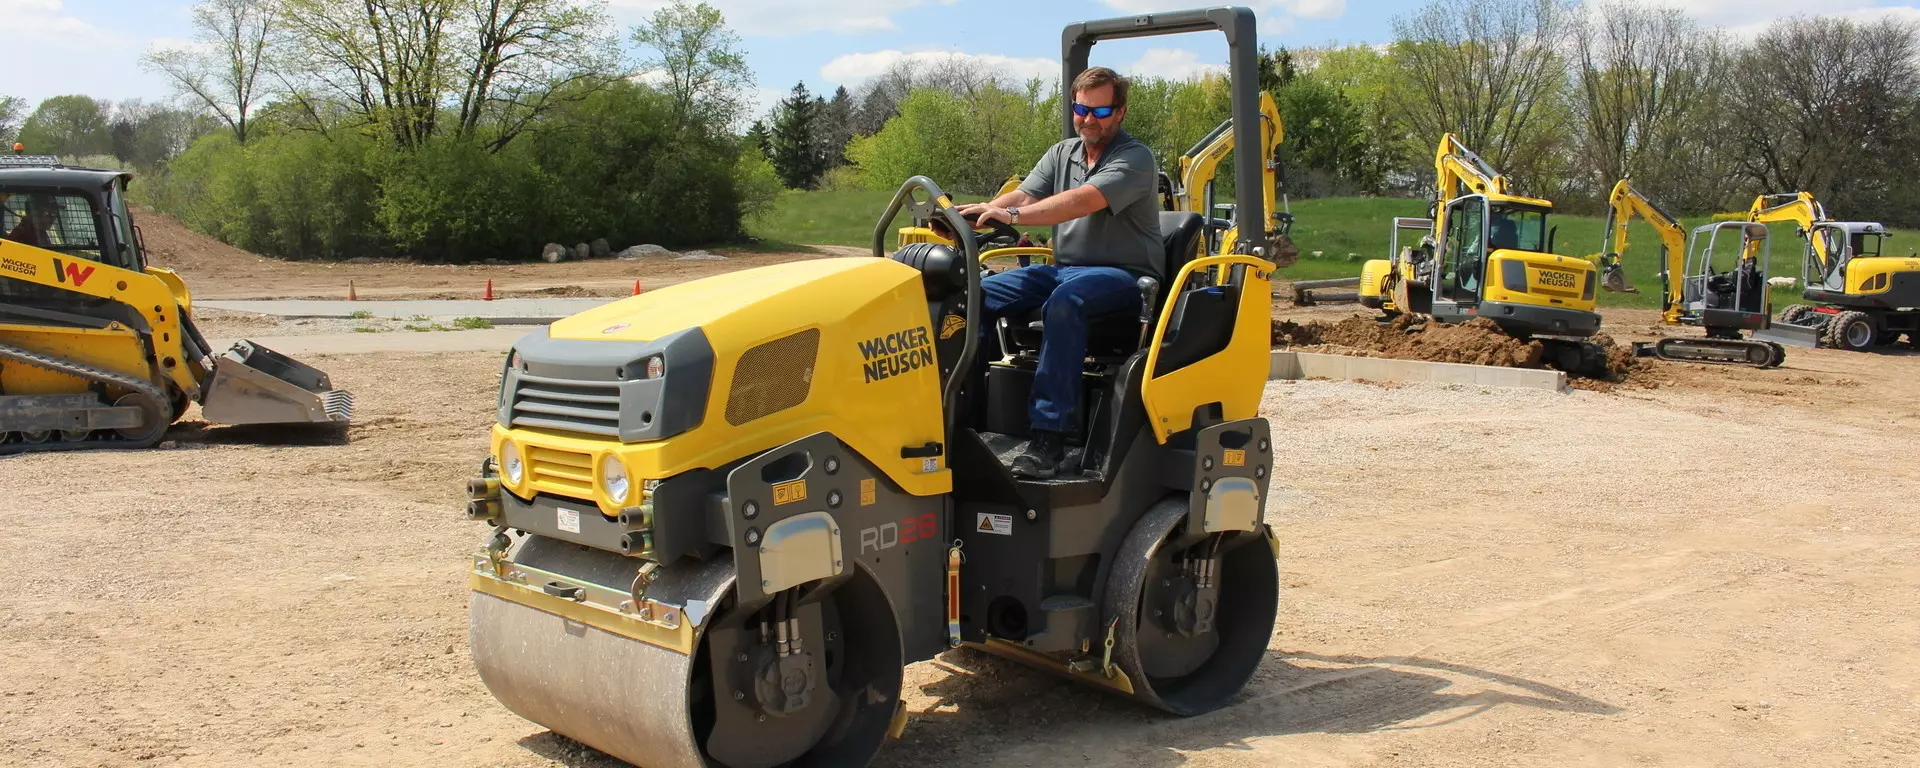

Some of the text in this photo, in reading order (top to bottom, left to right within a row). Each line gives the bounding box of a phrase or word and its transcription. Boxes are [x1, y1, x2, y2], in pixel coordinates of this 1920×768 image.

[1, 263, 36, 276] NEUSON
[2, 257, 37, 270] WACKER
[1539, 270, 1575, 281] WACKER
[1539, 277, 1576, 288] NEUSON
[857, 326, 930, 361] WACKER
[863, 346, 933, 384] NEUSON
[860, 512, 936, 555] RD28
